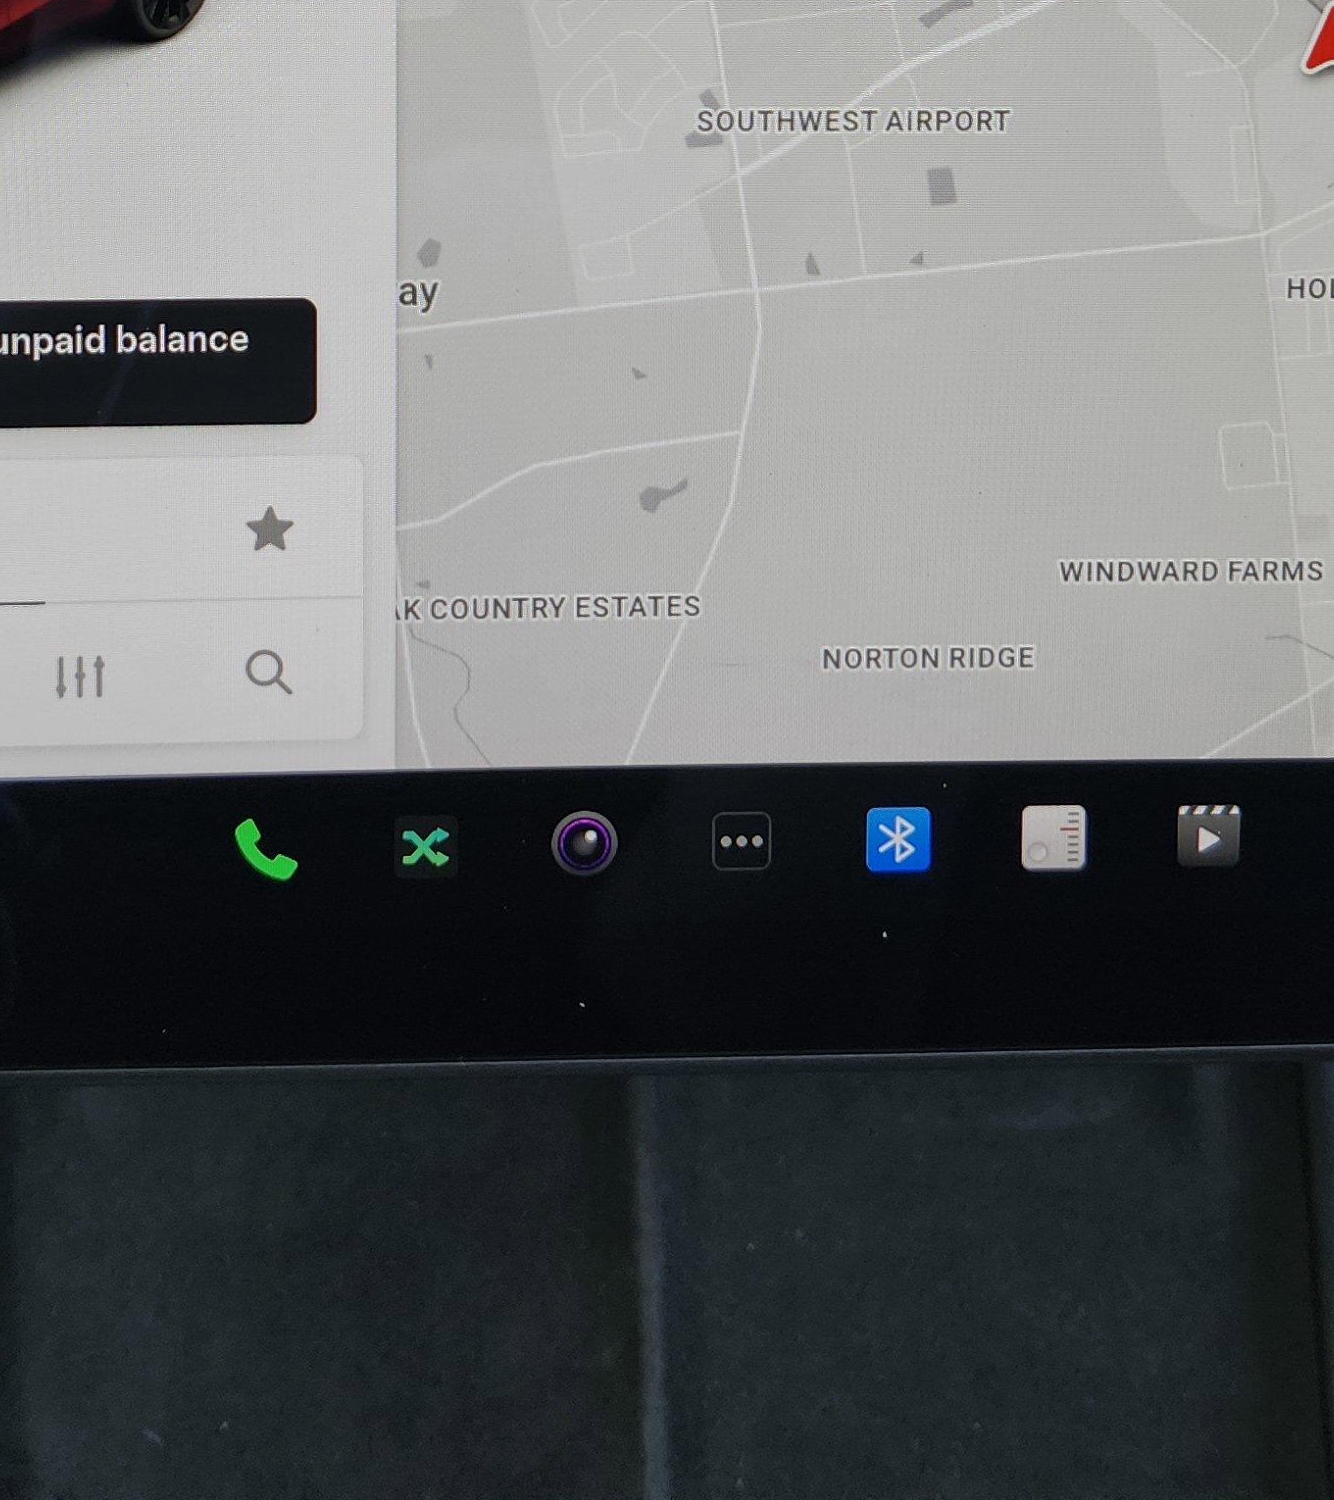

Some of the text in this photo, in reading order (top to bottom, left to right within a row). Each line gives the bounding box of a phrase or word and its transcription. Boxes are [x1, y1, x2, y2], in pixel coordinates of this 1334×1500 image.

[696, 109, 1011, 132] SOUTHWEST AIRPORT
[399, 282, 439, 313] ay
[117, 323, 249, 354] balance
[1060, 560, 1323, 582] WINDWARD FARMS
[430, 597, 566, 620] COUNTRY
[576, 595, 700, 618] ESTATES
[823, 647, 1033, 669] NORTON RIDGE
